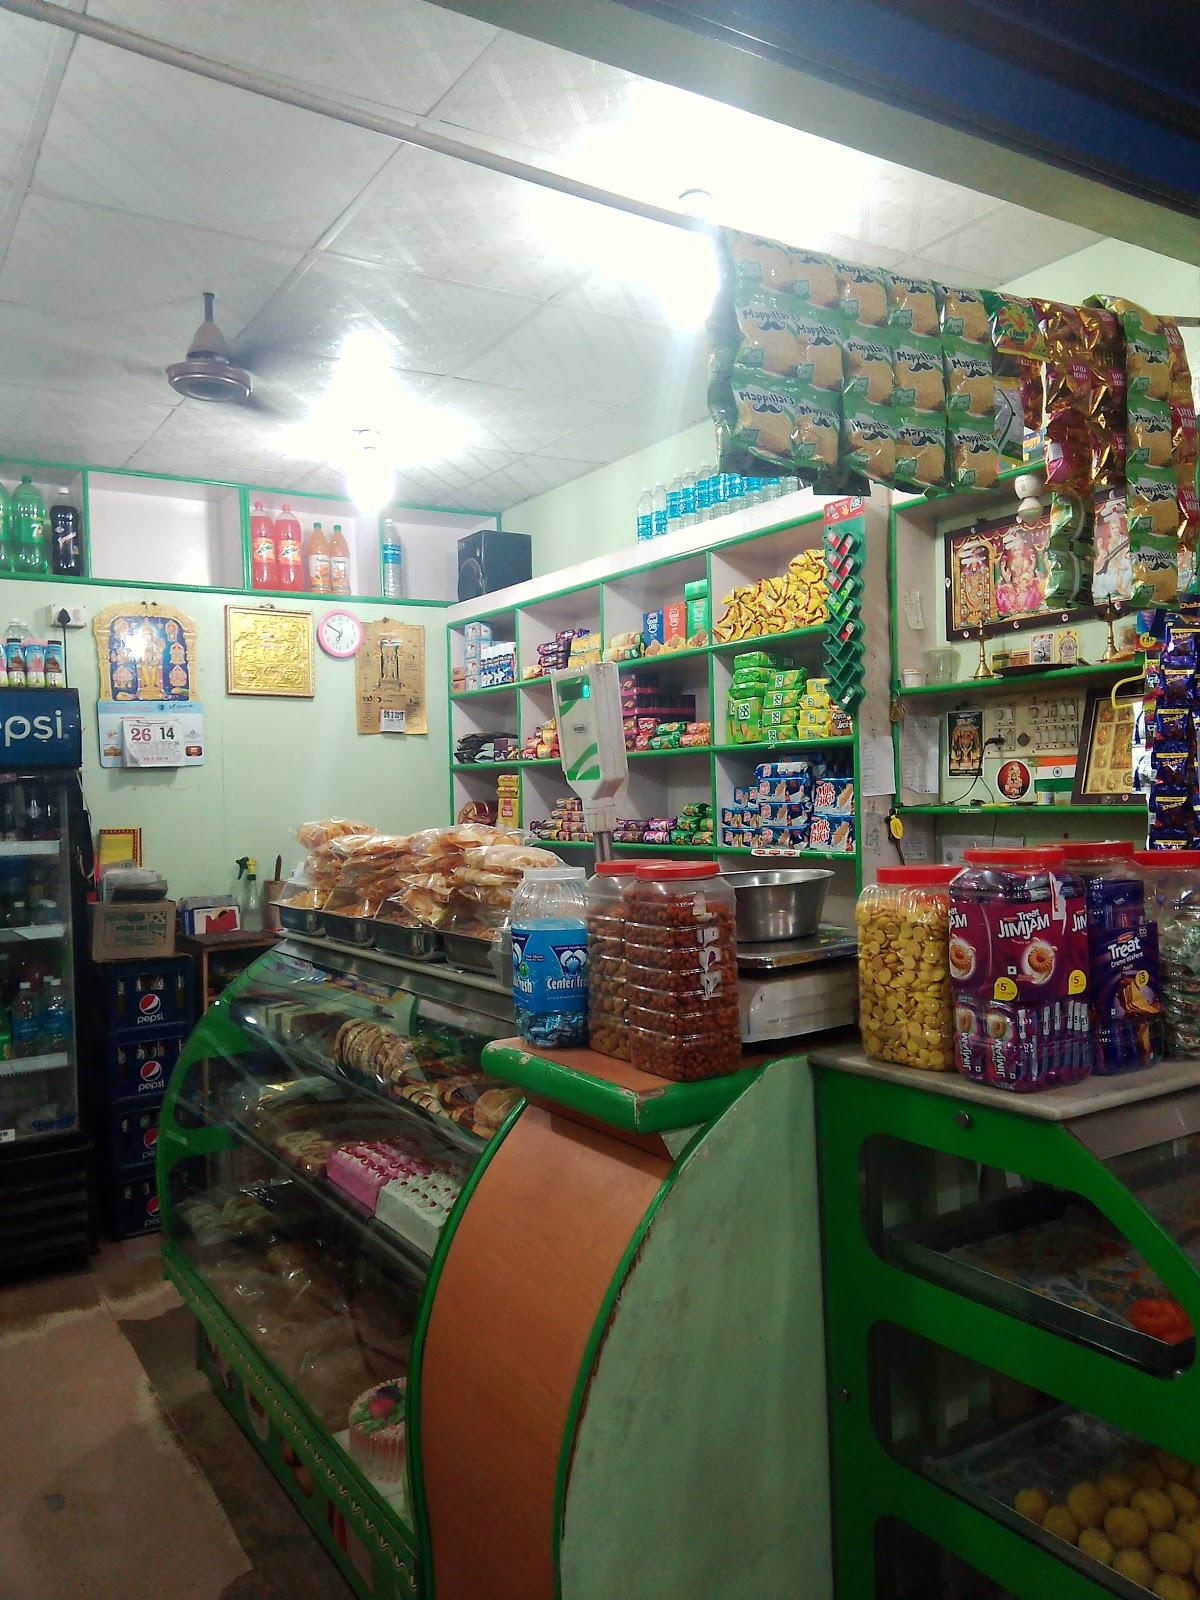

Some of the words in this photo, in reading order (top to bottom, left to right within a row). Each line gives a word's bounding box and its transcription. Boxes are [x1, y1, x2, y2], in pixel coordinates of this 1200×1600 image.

[0, 709, 62, 747] psi
[131, 728, 152, 741] 26
[160, 727, 175, 740] 14
[1016, 908, 1040, 921] Treat
[998, 914, 1050, 940] JIMJAM
[1108, 936, 1142, 960] Treat
[547, 976, 574, 990] Center
[137, 1012, 163, 1025] pepsi
[138, 1079, 164, 1093] pepsi
